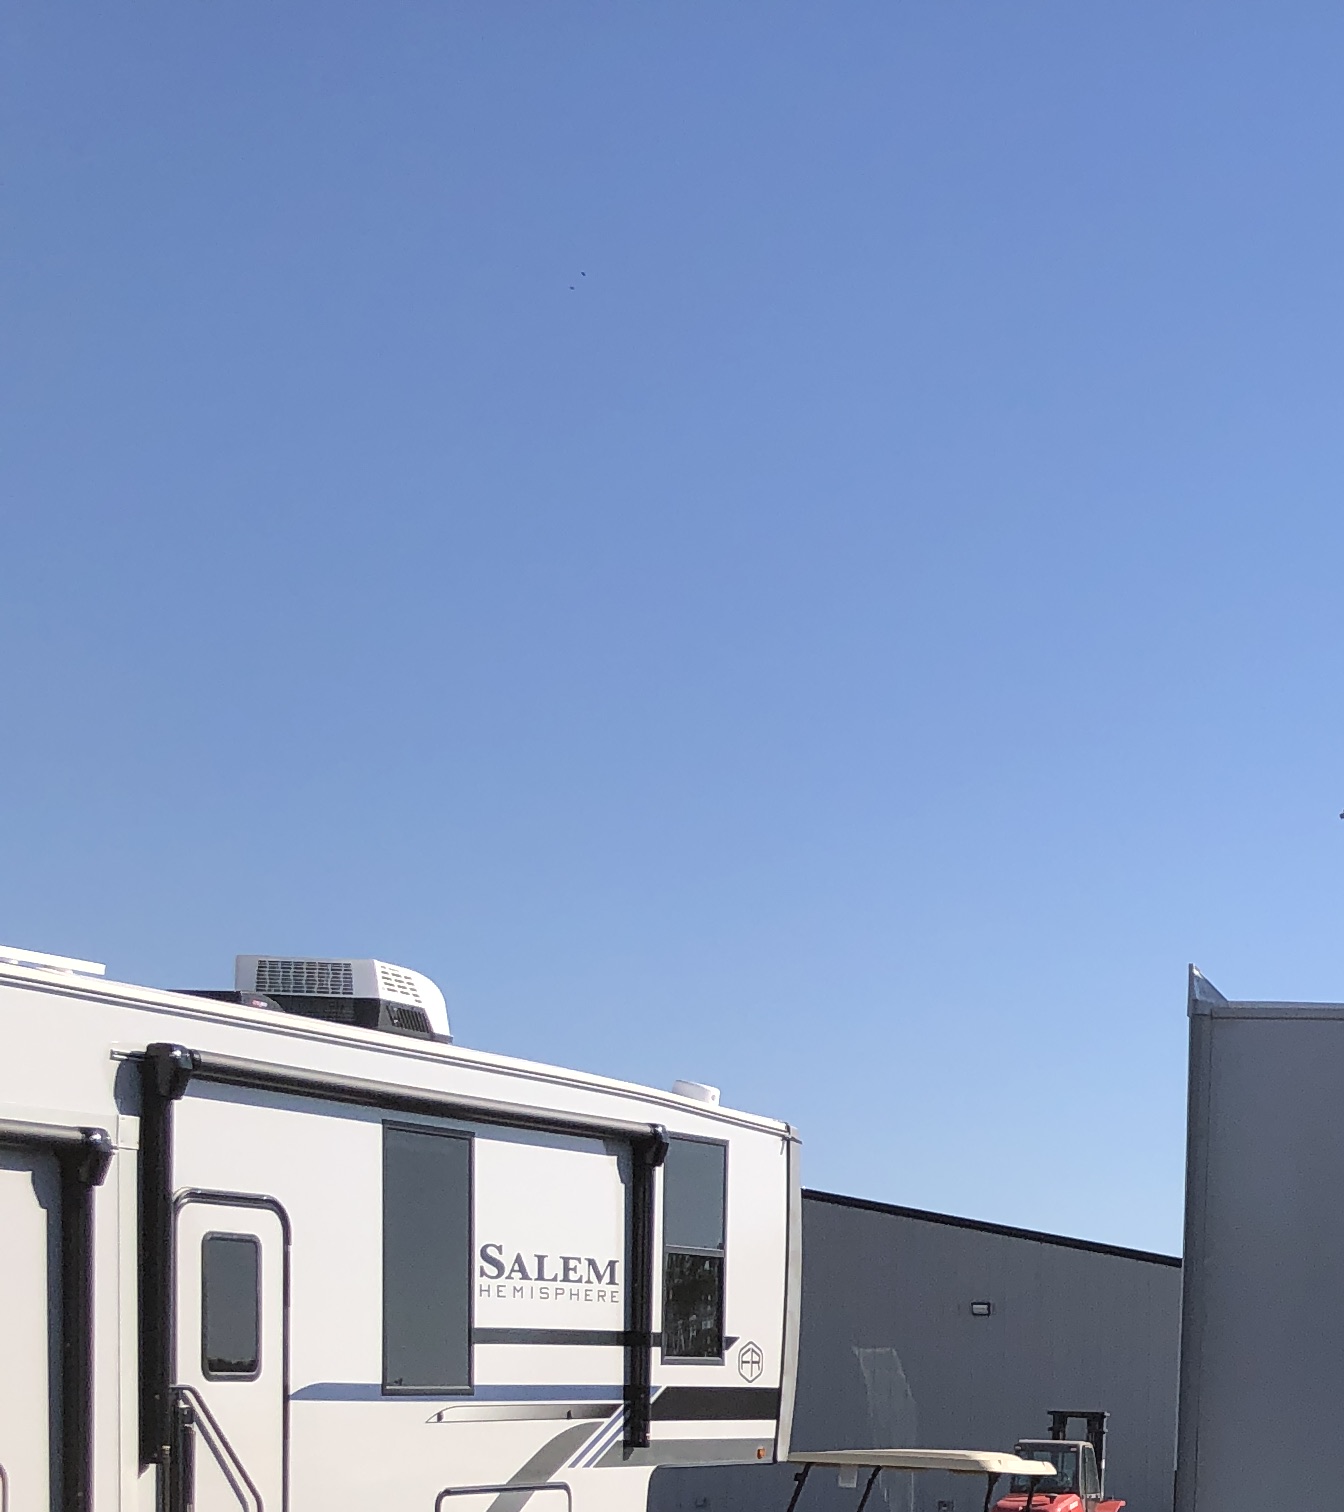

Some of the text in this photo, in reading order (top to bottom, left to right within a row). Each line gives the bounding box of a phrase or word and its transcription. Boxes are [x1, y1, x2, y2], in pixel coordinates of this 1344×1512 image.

[479, 1243, 620, 1286] SALEM
[479, 1284, 620, 1304] HEMISPHERE
[740, 1346, 762, 1380] FR
